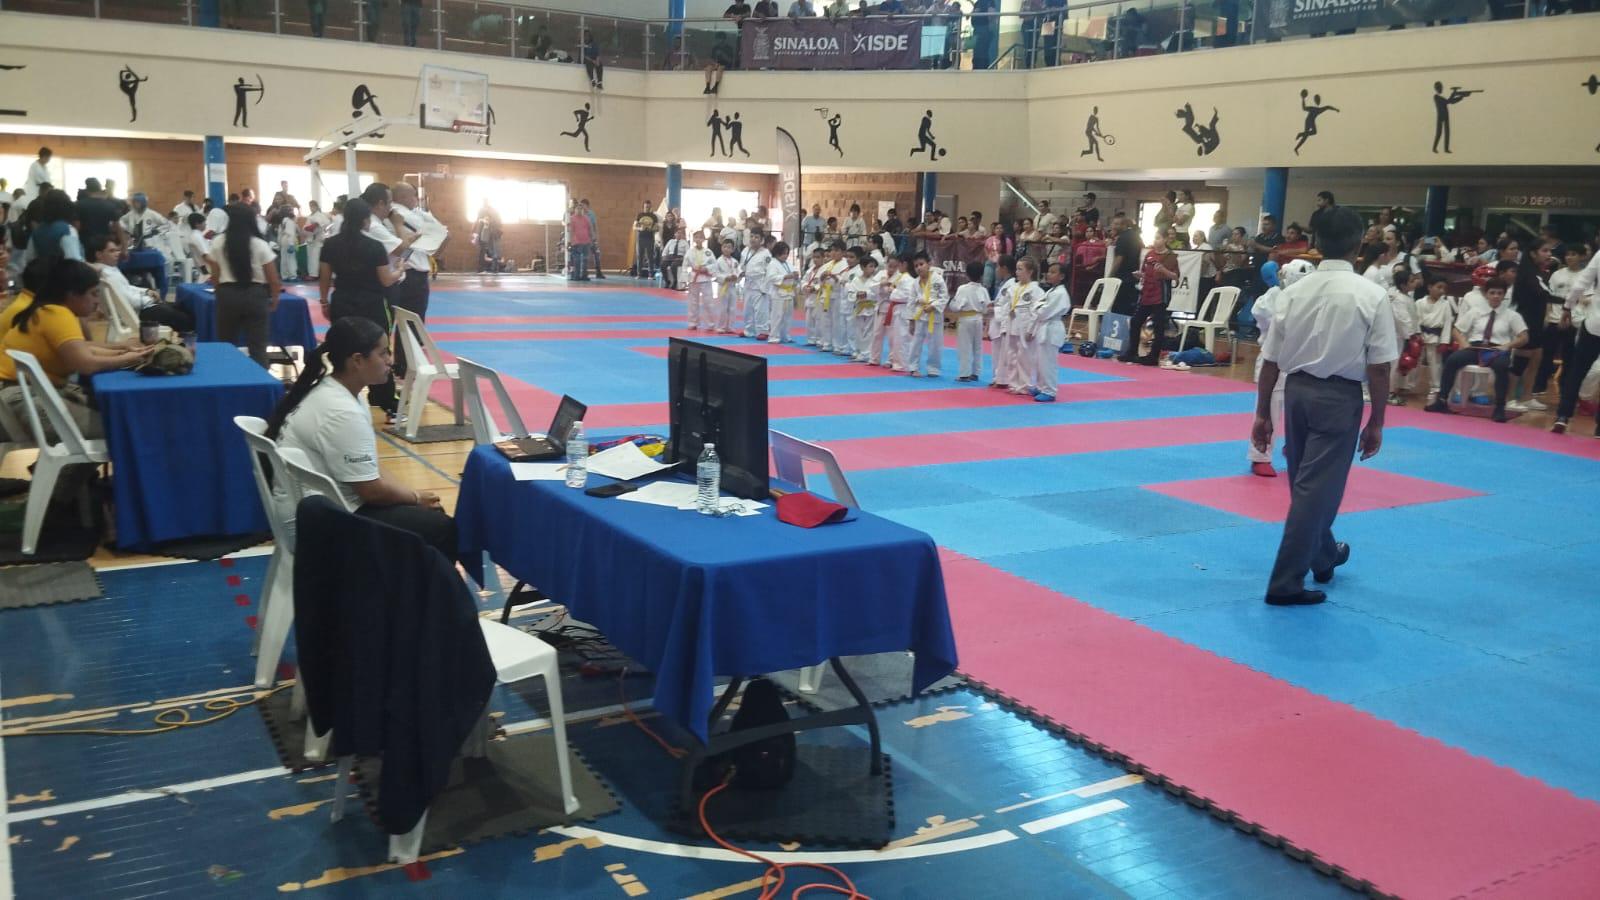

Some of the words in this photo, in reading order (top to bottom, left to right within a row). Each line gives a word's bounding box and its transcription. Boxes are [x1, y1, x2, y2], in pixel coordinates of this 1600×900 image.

[774, 36, 840, 50] SINALOA
[868, 34, 909, 51] ISDE
[1110, 320, 1120, 338] 3
